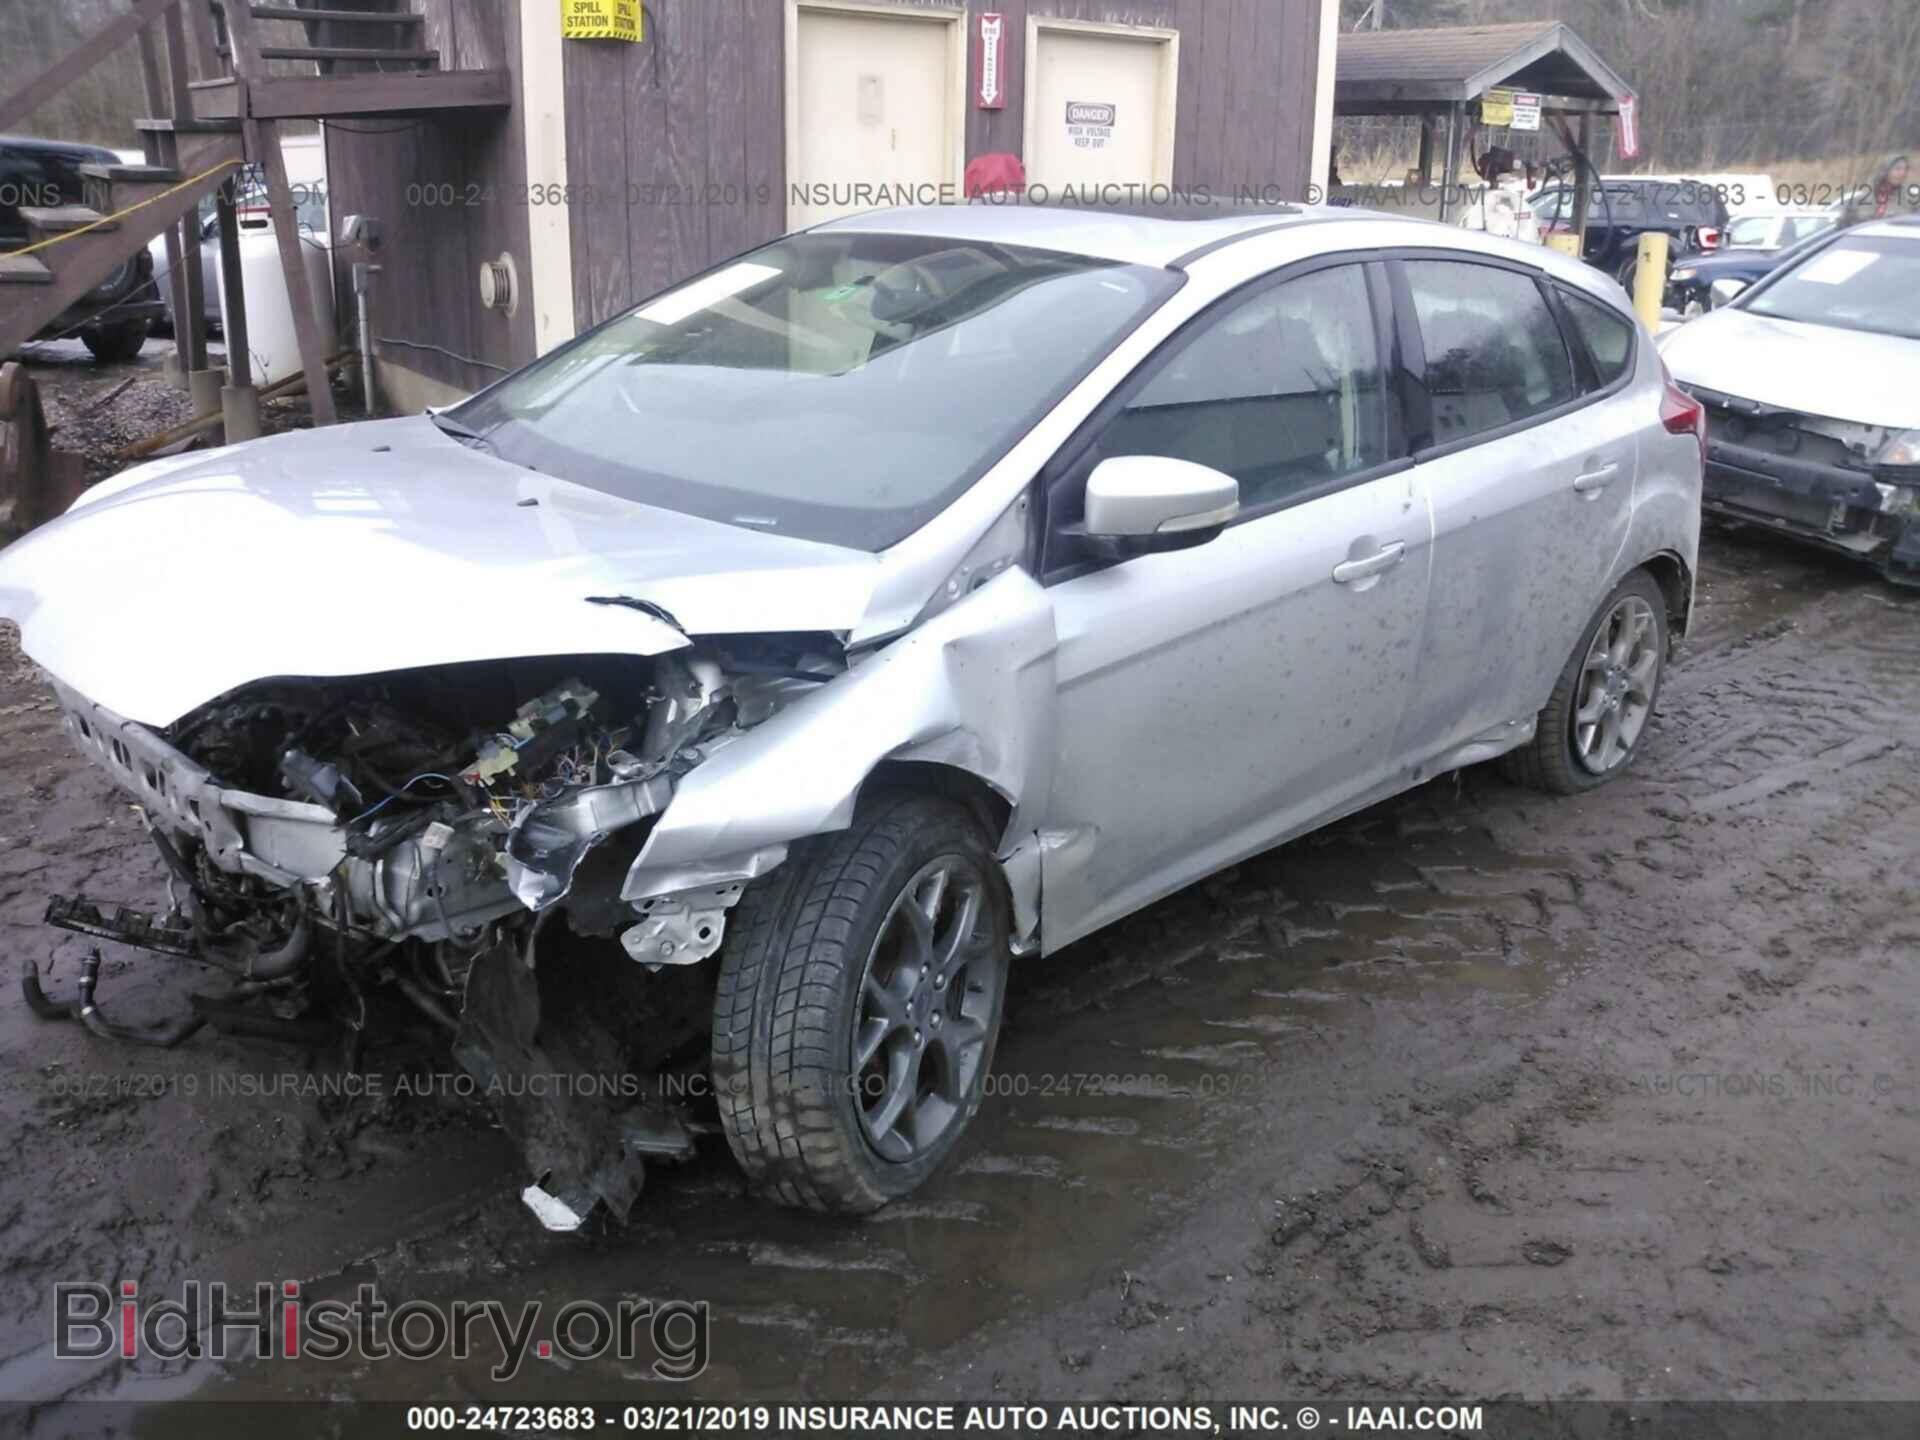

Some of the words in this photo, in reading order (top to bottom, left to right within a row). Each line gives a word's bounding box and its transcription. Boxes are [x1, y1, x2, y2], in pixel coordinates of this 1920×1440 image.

[573, 2, 602, 13] SPILL
[567, 15, 608, 27] STATION
[1072, 107, 1110, 121] DANGER
